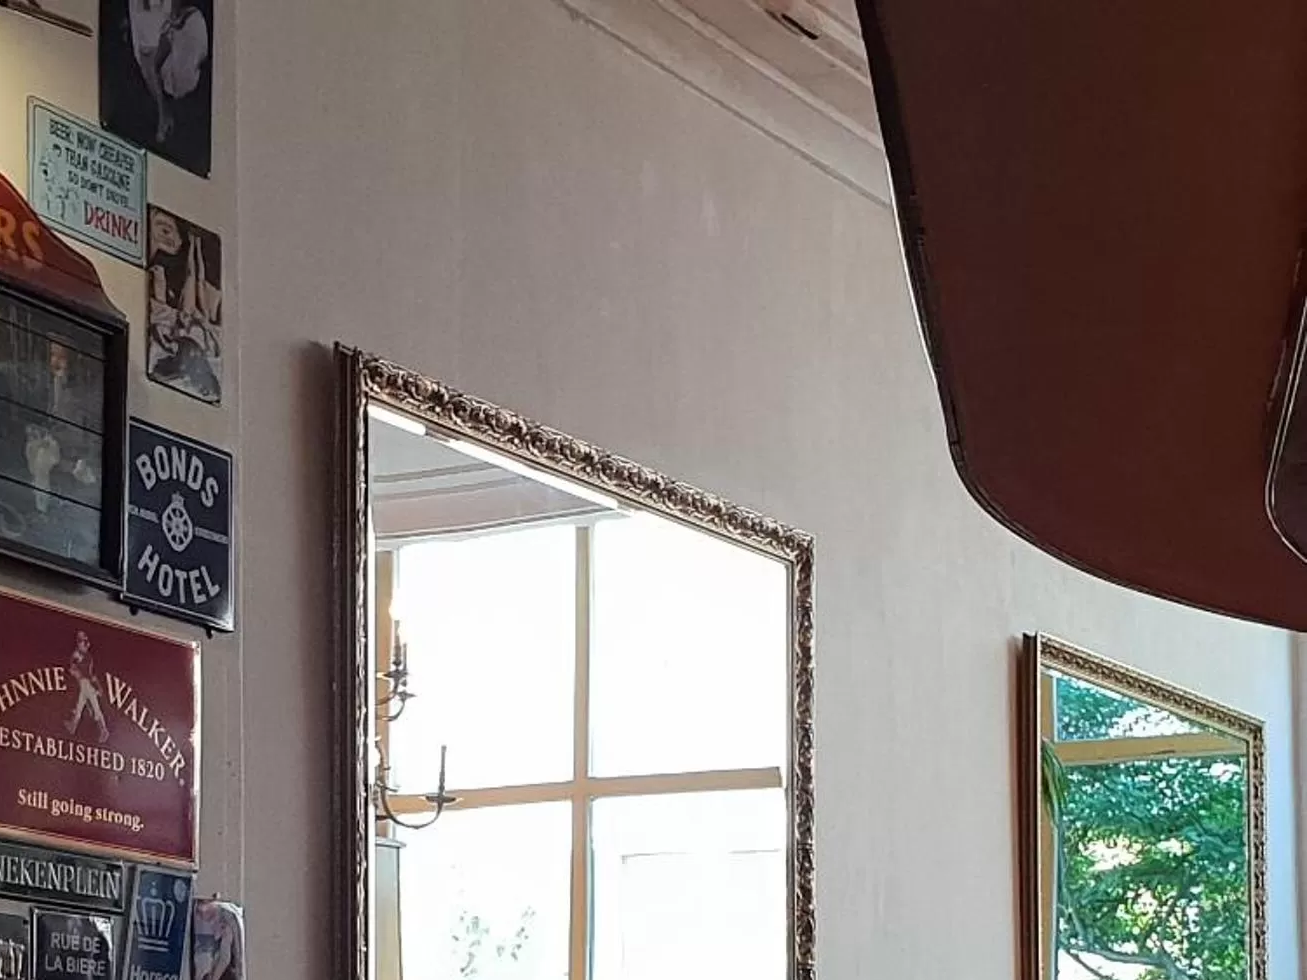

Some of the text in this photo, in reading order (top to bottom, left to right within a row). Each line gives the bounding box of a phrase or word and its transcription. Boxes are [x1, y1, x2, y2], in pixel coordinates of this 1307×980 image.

[84, 200, 138, 244] DRINK!
[135, 445, 219, 508] BONDS
[137, 544, 221, 604] HOTEL
[130, 757, 165, 782] 1820
[17, 788, 144, 832] Still going strong.
[45, 953, 63, 972] LA
[50, 931, 101, 953] RUE DE
